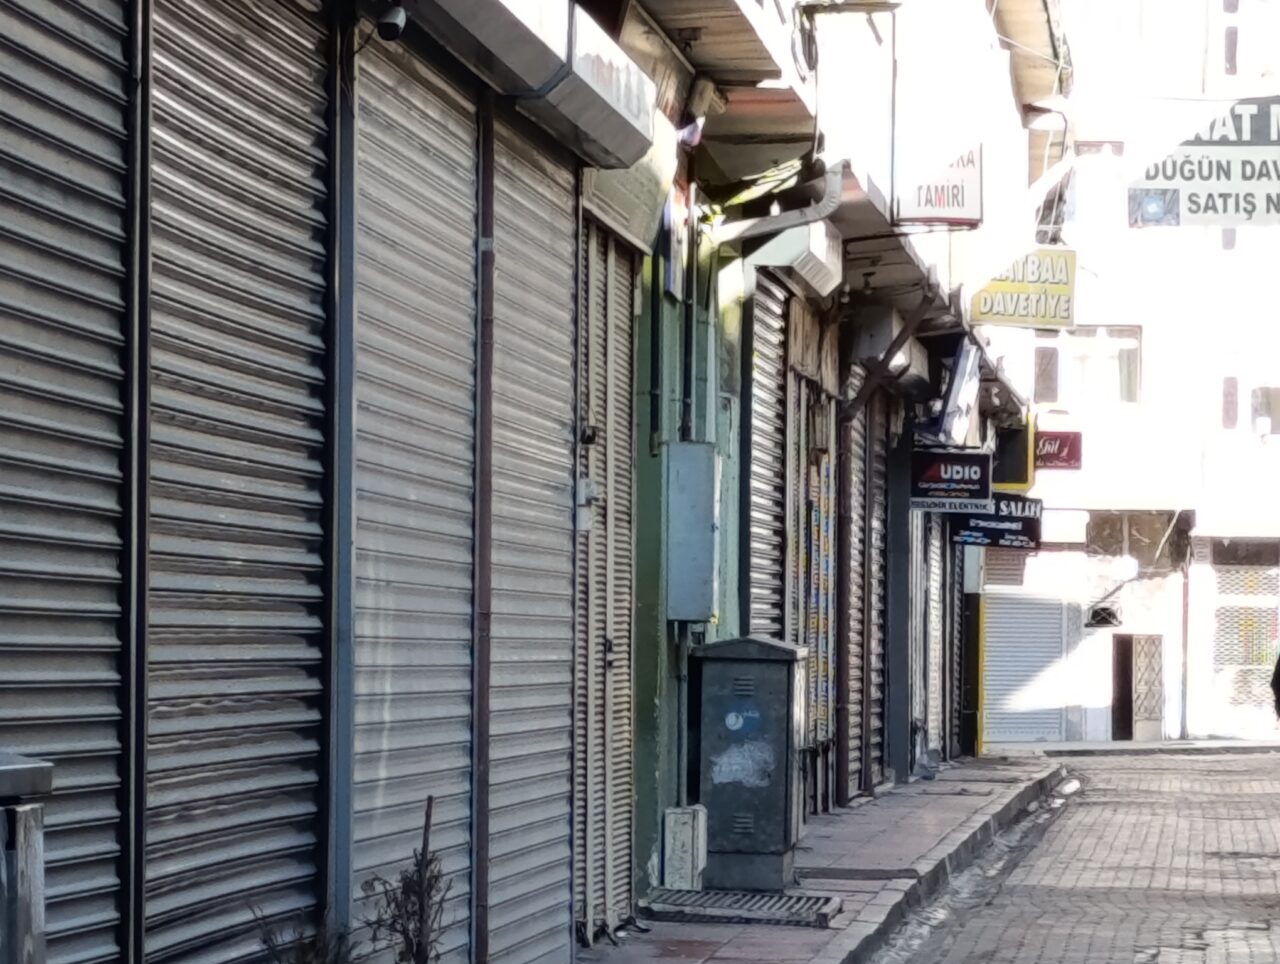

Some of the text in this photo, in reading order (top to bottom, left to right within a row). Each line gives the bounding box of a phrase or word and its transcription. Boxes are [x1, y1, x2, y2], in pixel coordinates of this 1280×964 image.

[1145, 154, 1232, 181] DÜĞÜN
[1187, 192, 1256, 220] SATIŞ
[979, 288, 1071, 319] DAVETİYE
